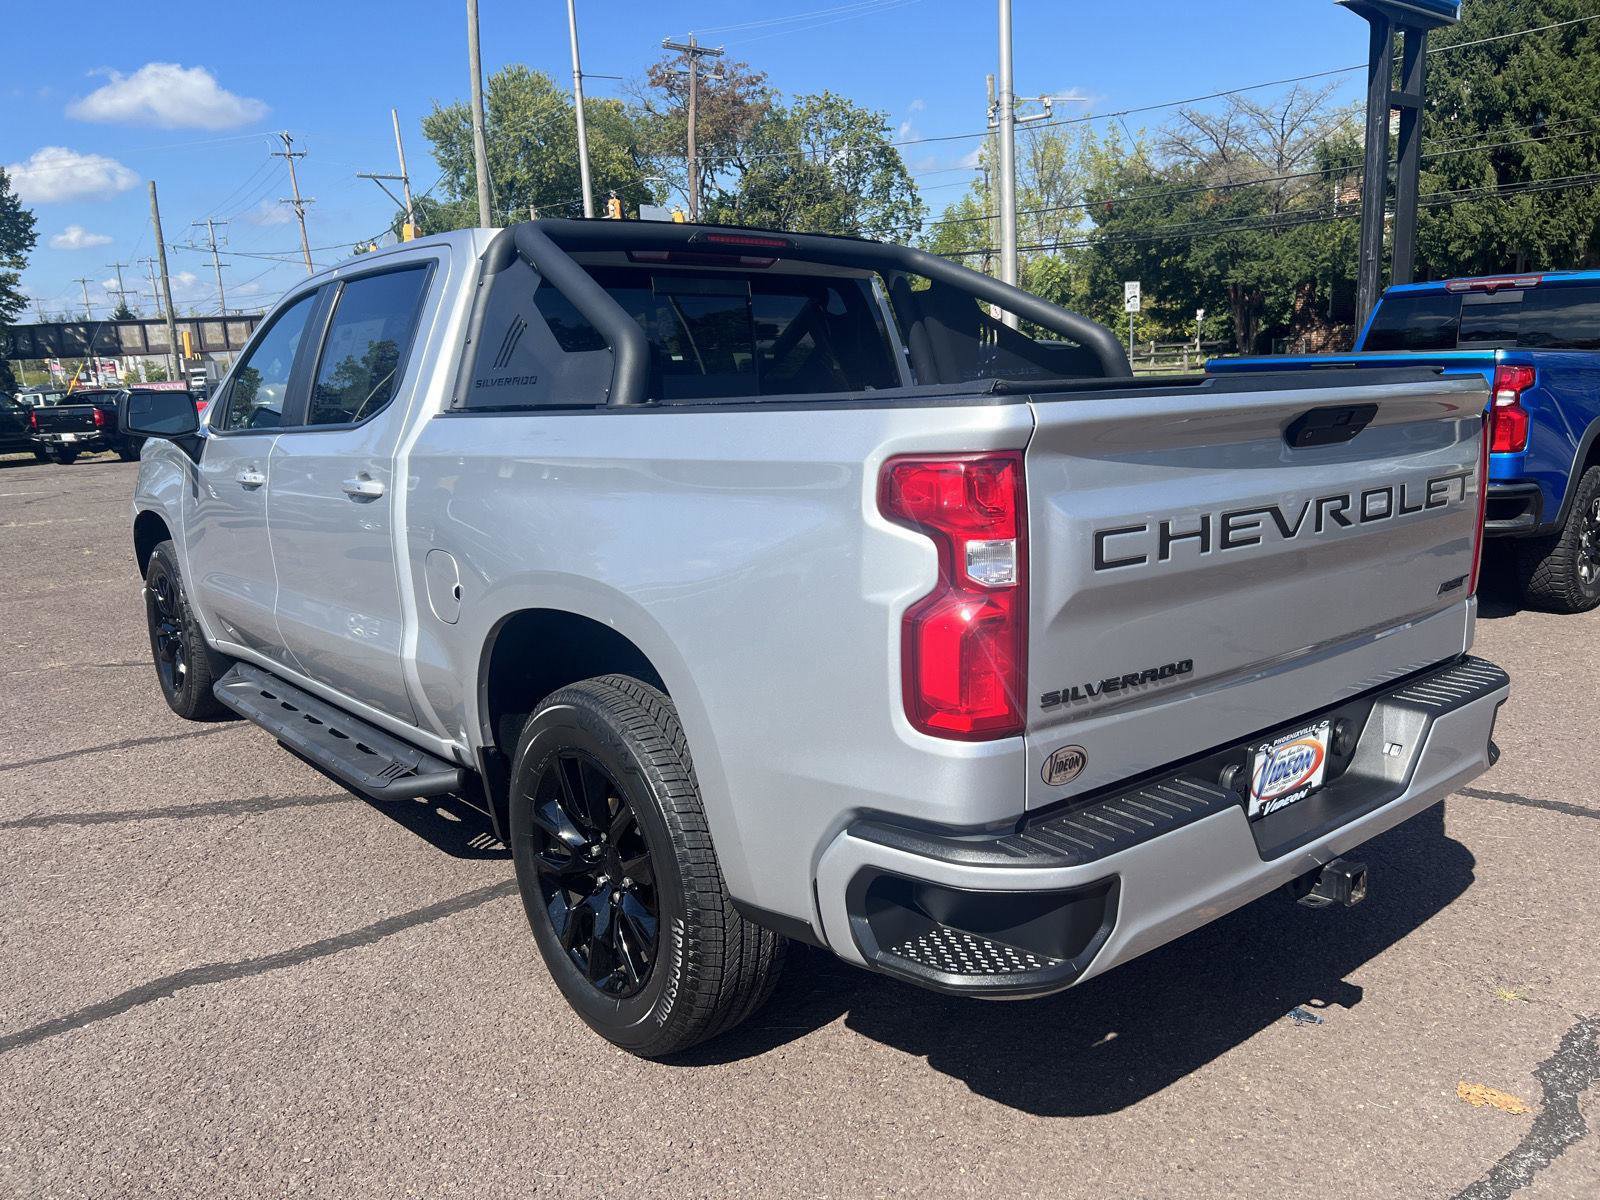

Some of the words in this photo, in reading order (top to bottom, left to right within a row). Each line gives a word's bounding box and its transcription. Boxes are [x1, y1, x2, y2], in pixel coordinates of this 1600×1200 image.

[475, 375, 538, 389] SILVERADO
[1093, 471, 1474, 572] CHEVROLET
[1040, 658, 1194, 708] SILVERADO
[1273, 724, 1317, 746] PHOENIXVILLE
[1048, 753, 1081, 784] VIDEON
[1263, 788, 1309, 816] VIDEON
